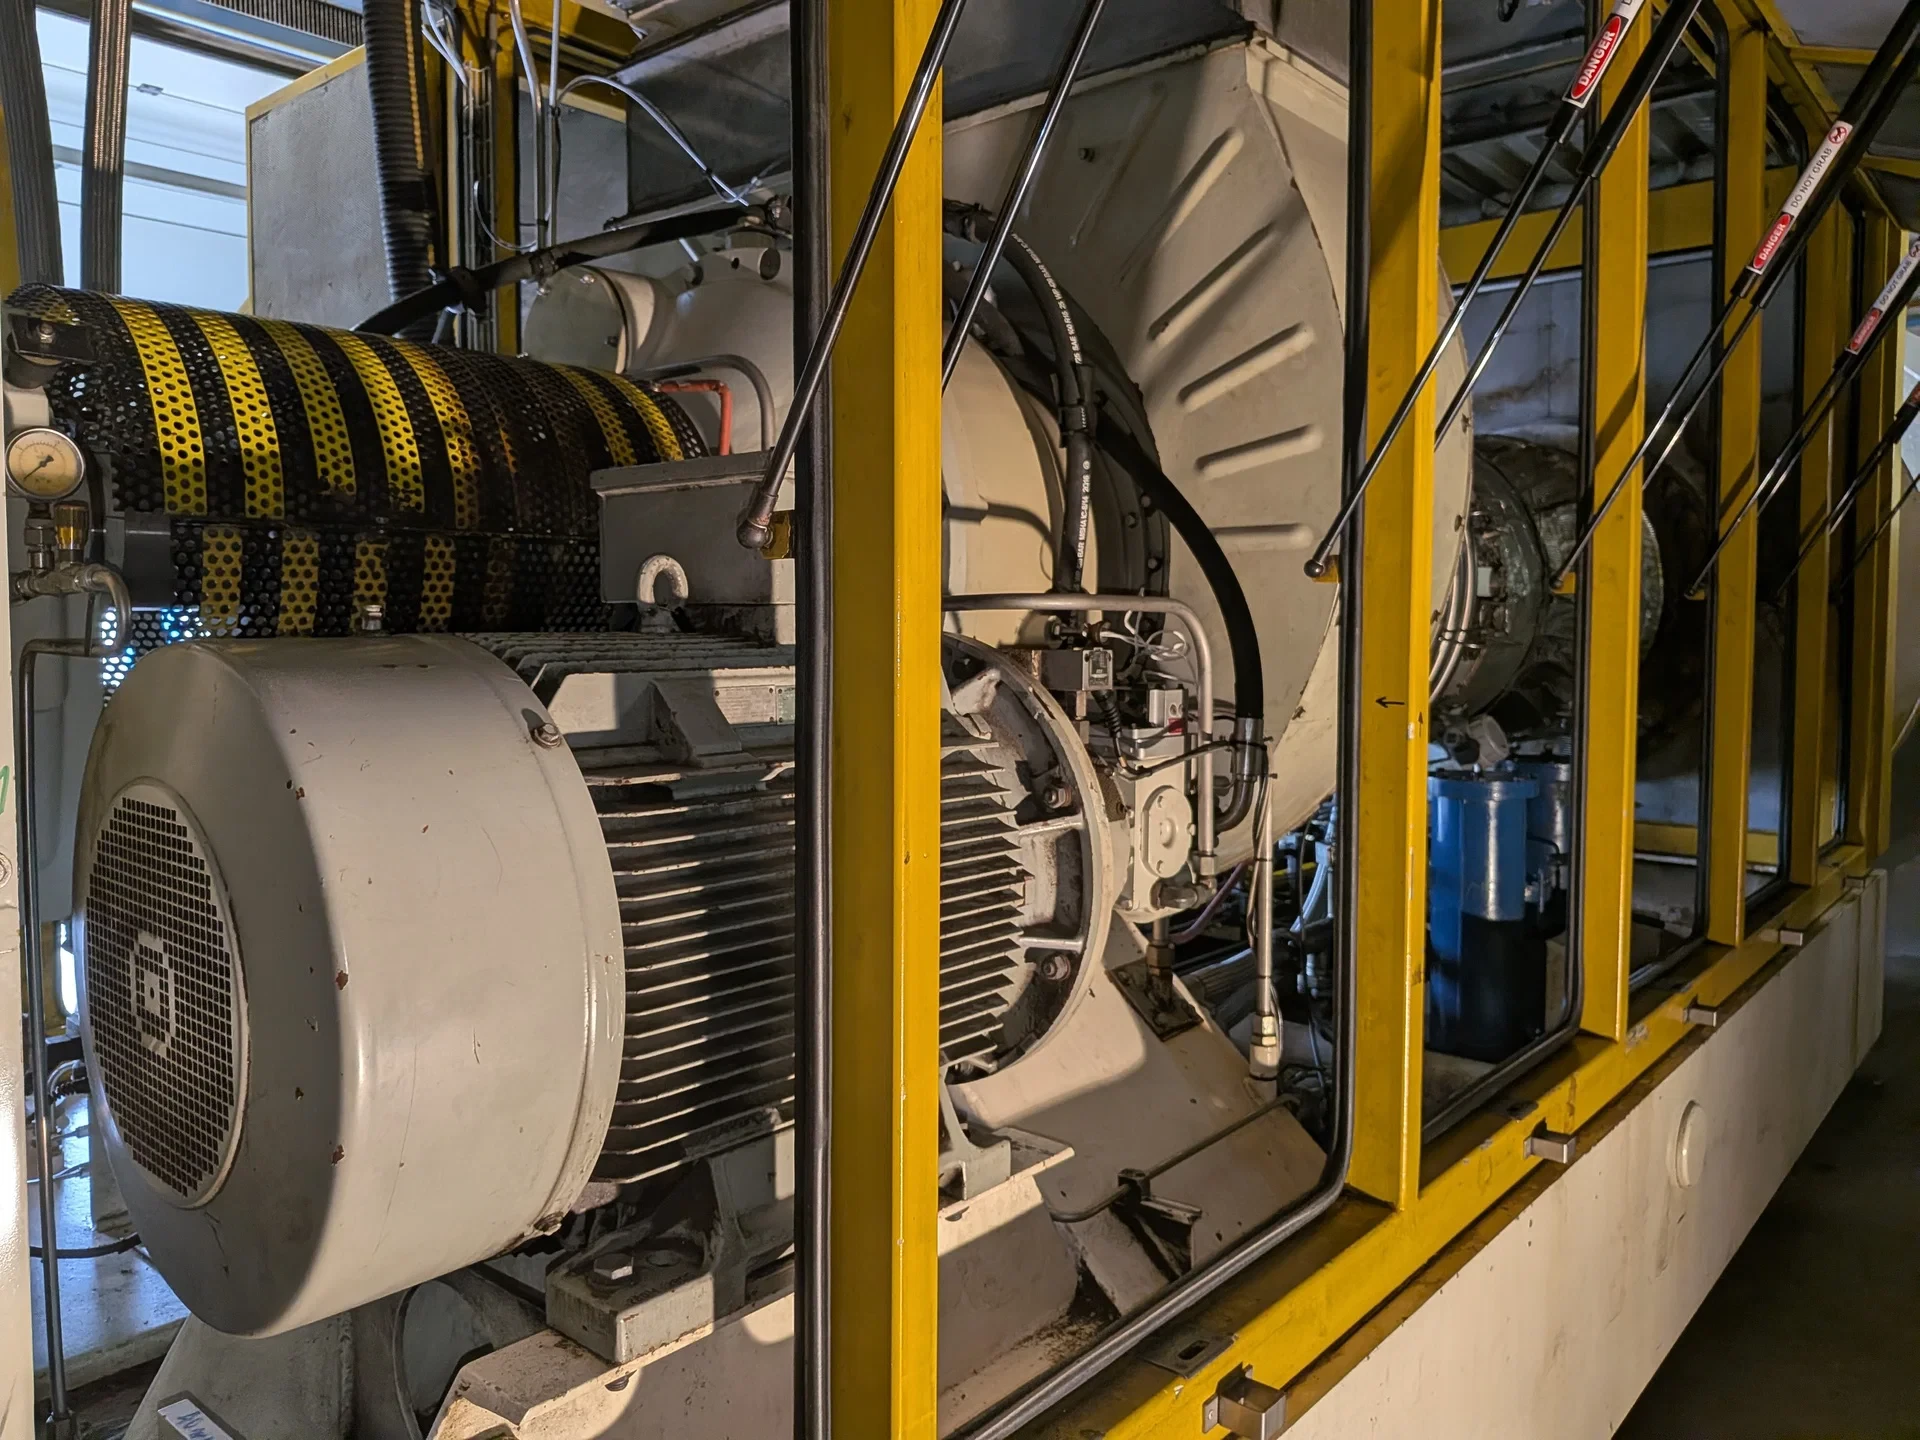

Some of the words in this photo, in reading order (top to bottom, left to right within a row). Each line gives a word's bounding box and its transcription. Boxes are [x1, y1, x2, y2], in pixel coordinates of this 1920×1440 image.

[1579, 31, 1615, 86] DANGER
[1759, 223, 1786, 260] DANGER
[1791, 194, 1803, 208] DO
[1800, 175, 1815, 194] NOT
[1813, 147, 1832, 174] GRAB
